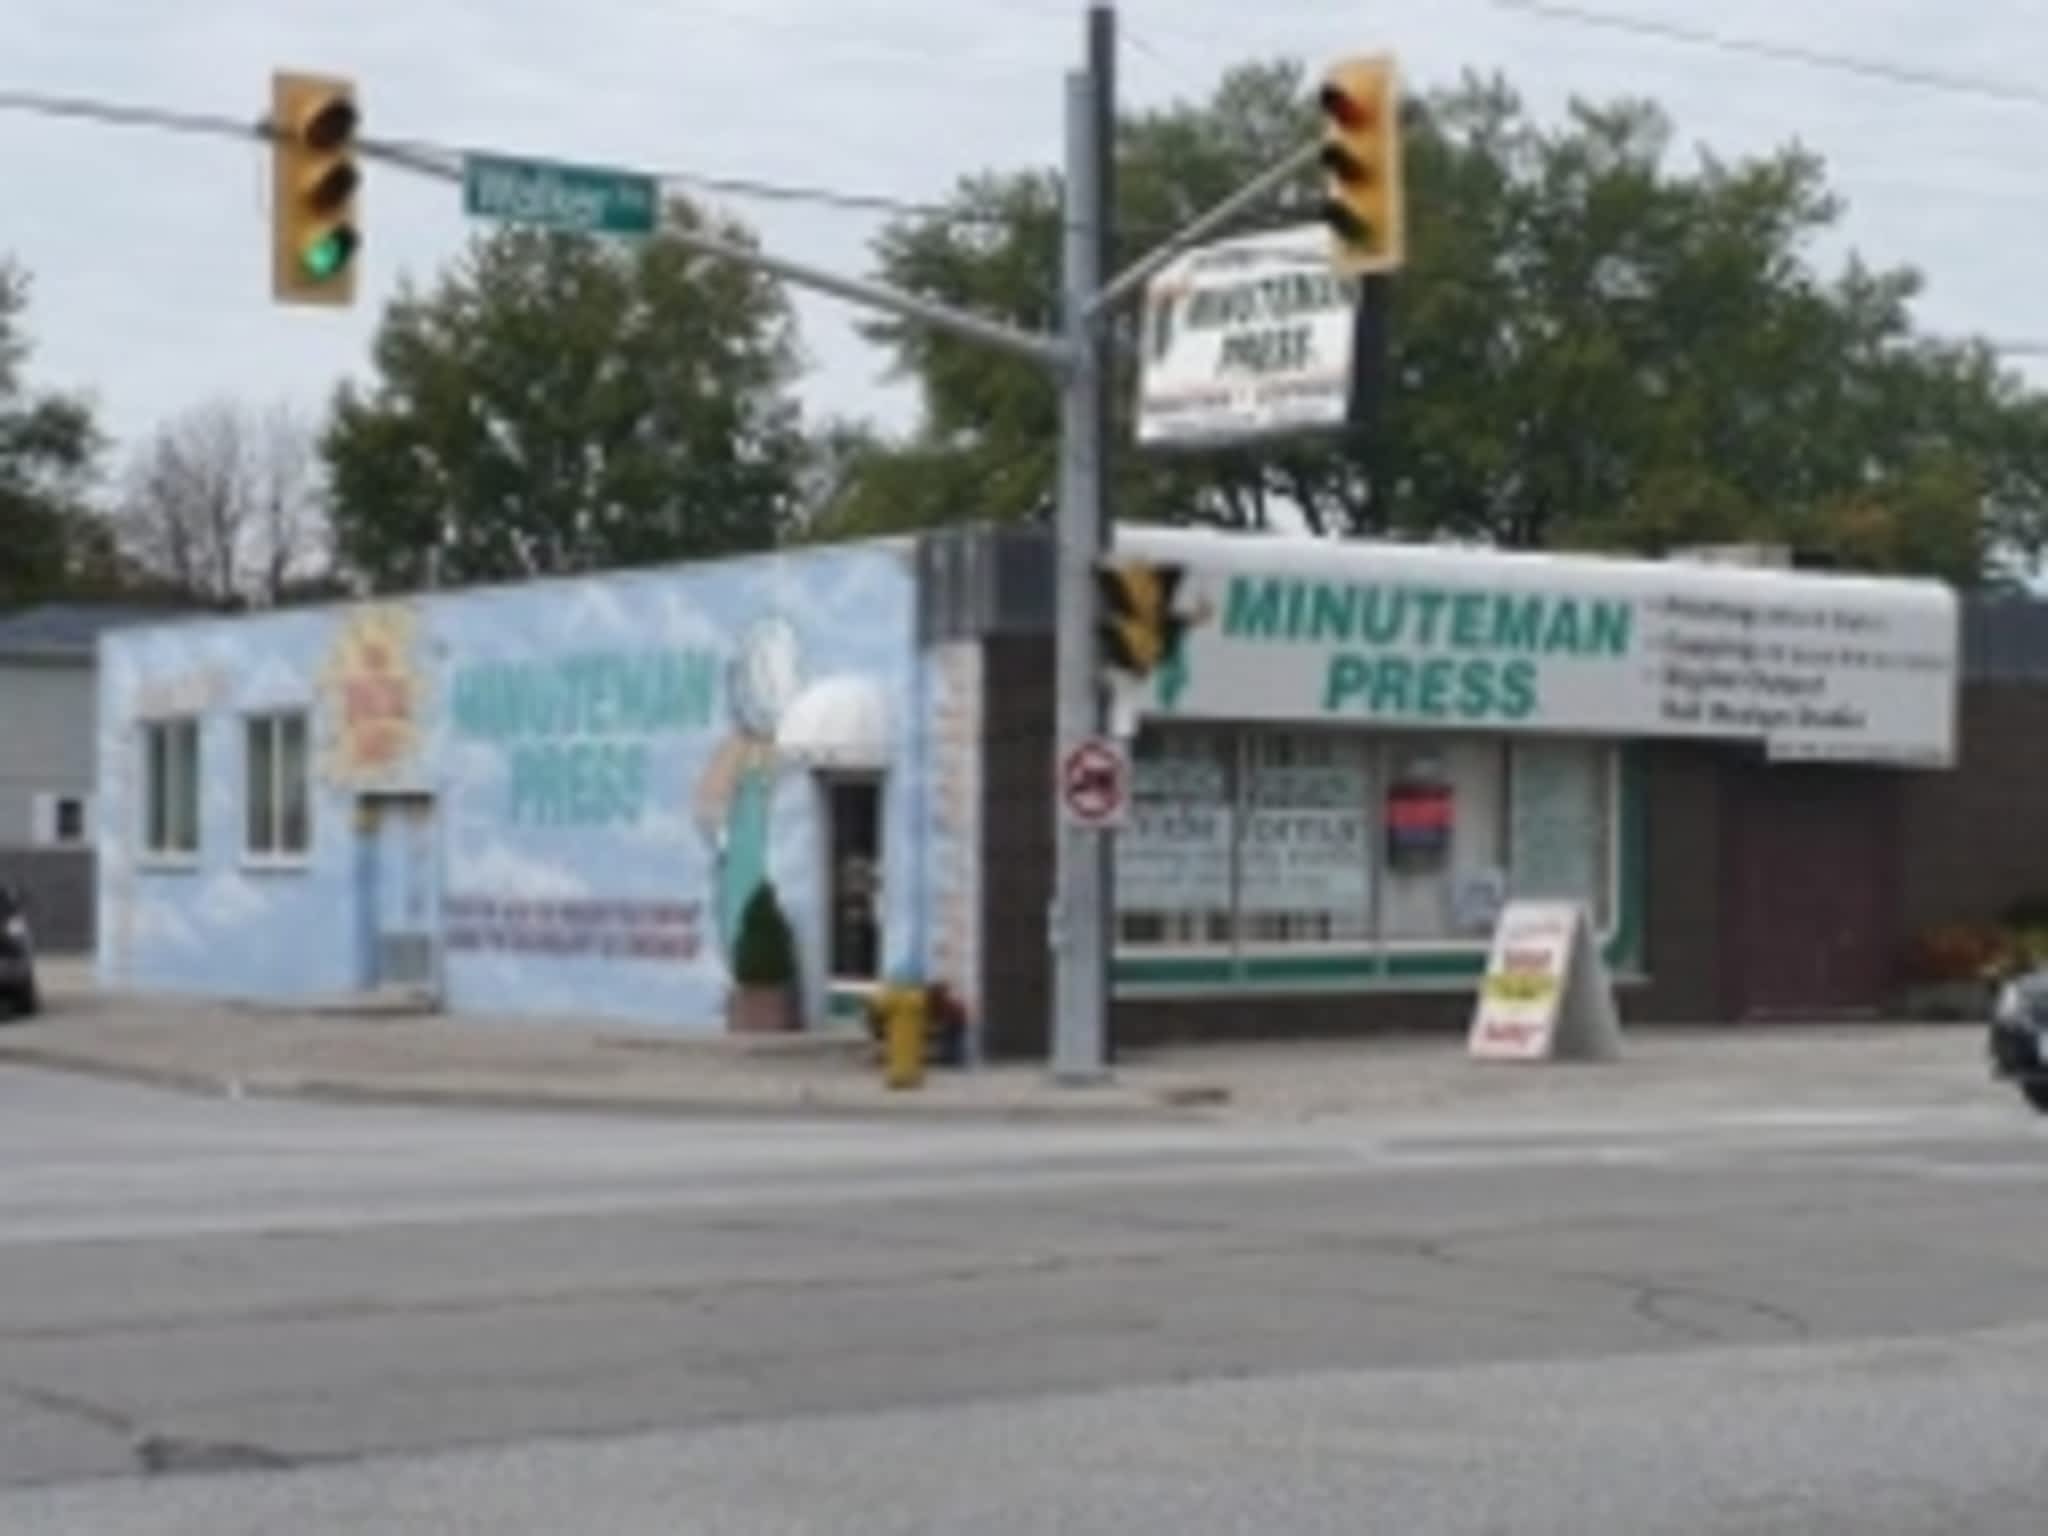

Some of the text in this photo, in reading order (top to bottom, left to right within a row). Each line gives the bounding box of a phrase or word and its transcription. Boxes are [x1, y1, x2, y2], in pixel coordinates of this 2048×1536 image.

[1218, 325, 1313, 376] PRESS
[1223, 577, 1631, 653] MINUTEMAN
[452, 649, 717, 738] MINUTEMAN
[1323, 654, 1537, 717] PRESS
[510, 741, 645, 825] PRESS
